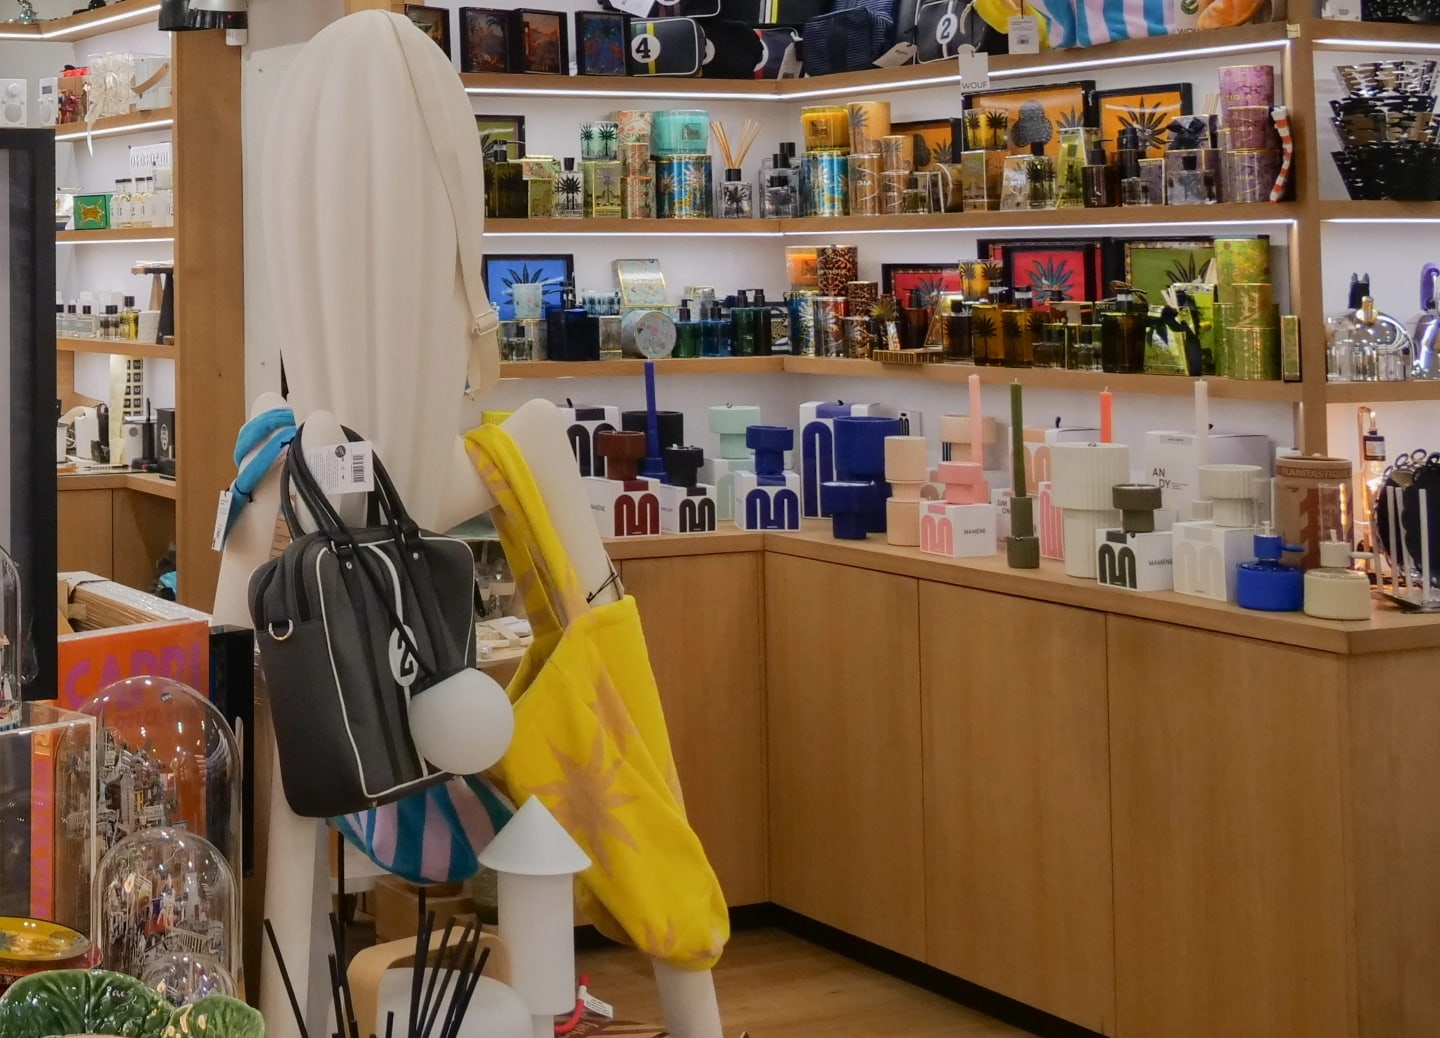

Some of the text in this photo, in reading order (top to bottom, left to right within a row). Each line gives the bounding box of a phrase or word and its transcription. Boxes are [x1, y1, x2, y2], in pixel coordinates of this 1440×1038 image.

[940, 17, 953, 40] 2
[635, 37, 652, 58] 4
[961, 81, 988, 90] WOUF
[396, 632, 415, 678] 2
